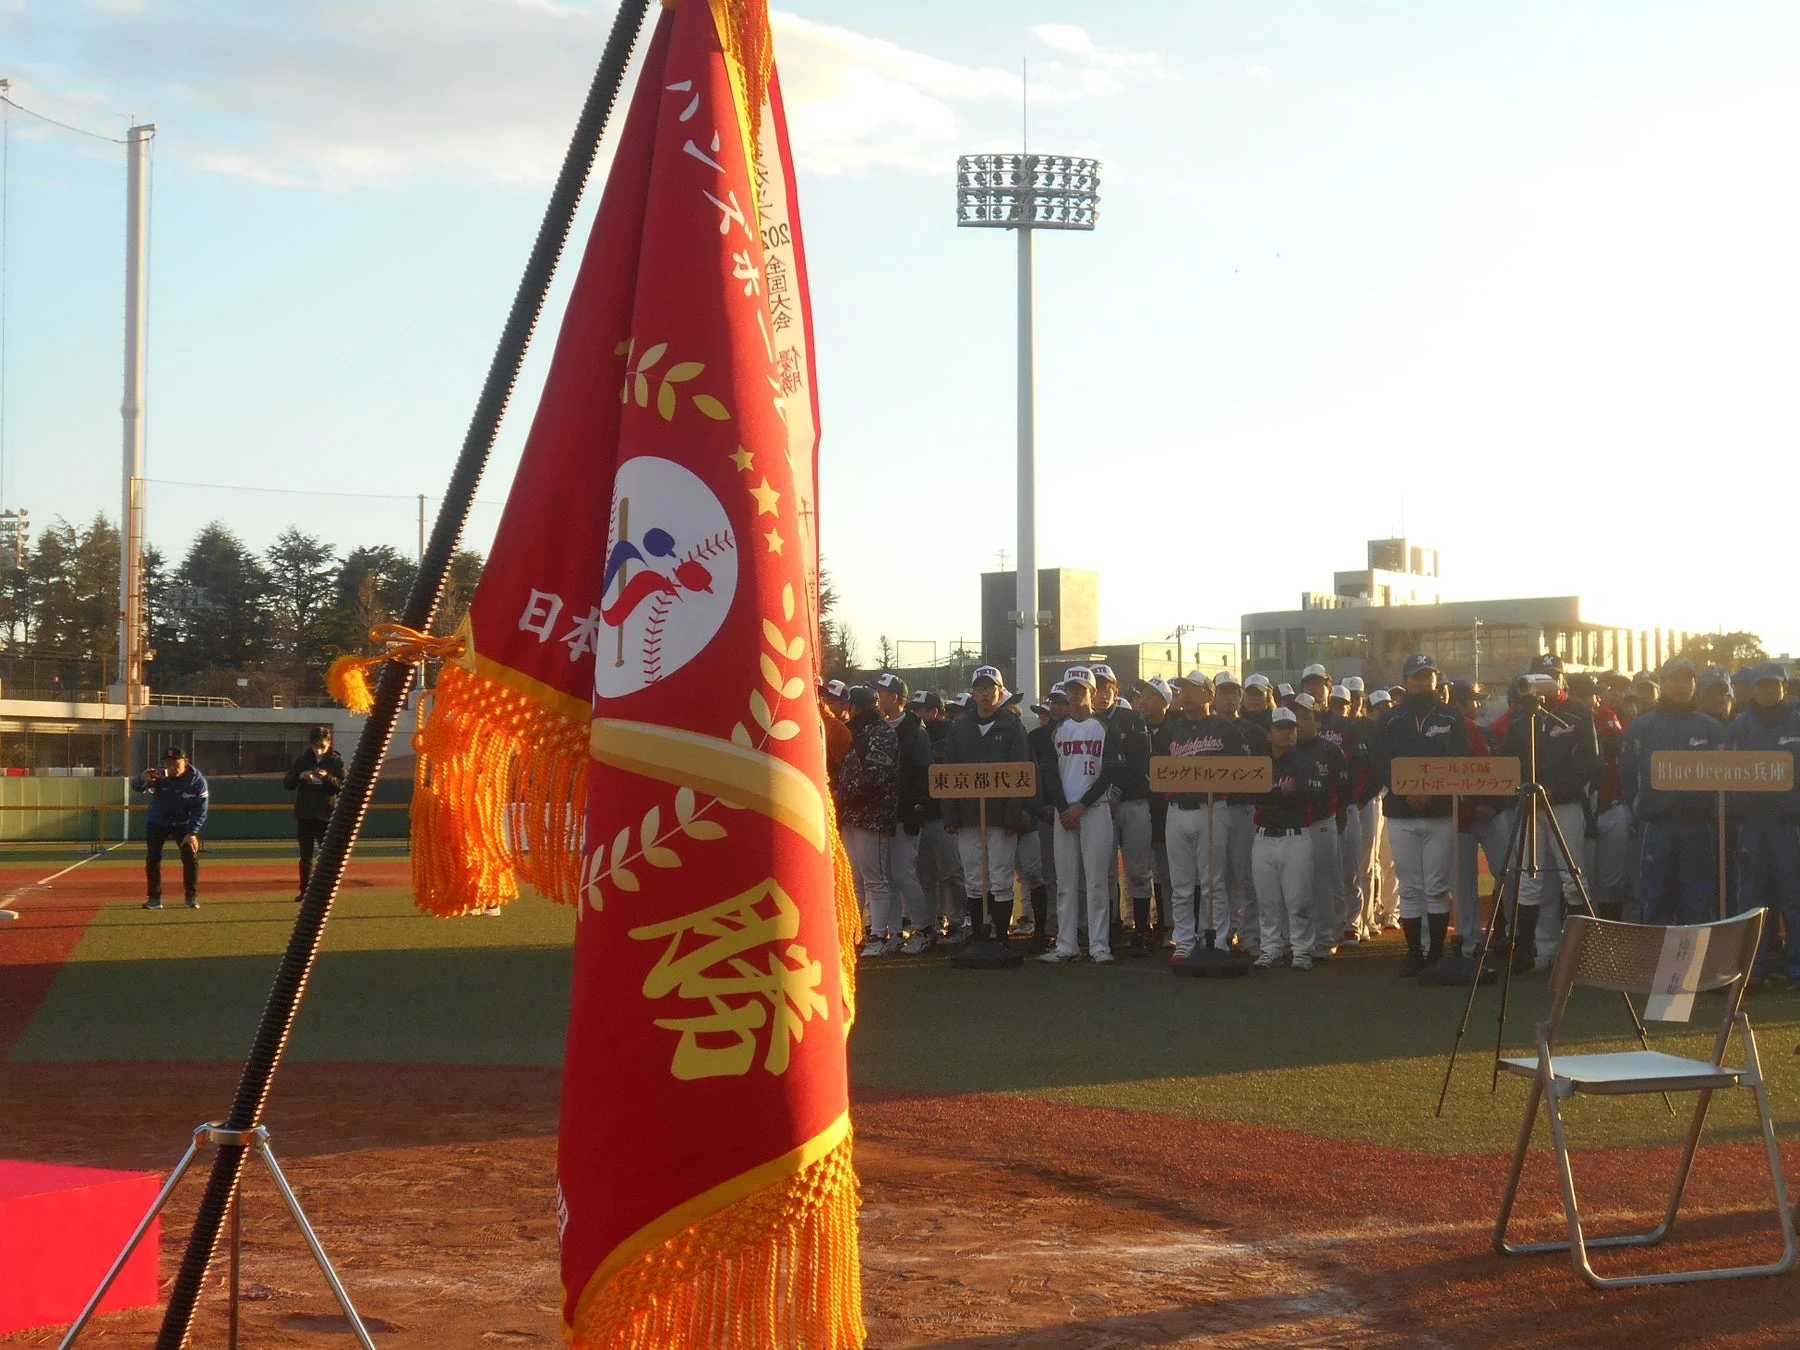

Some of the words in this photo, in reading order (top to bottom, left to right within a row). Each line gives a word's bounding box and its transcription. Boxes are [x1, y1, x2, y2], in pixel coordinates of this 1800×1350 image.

[518, 587, 600, 662] 日本
[1057, 740, 1103, 758] TOKYO
[1083, 760, 1096, 776] 15
[1157, 767, 1265, 780] ビッグドルフィンズ
[1419, 761, 1491, 774] オール宮城
[1657, 761, 1692, 780] Blue
[933, 770, 1032, 791] 東京都代表
[1395, 777, 1515, 791] ソフトボールクラブ
[628, 877, 828, 1081] 勝
